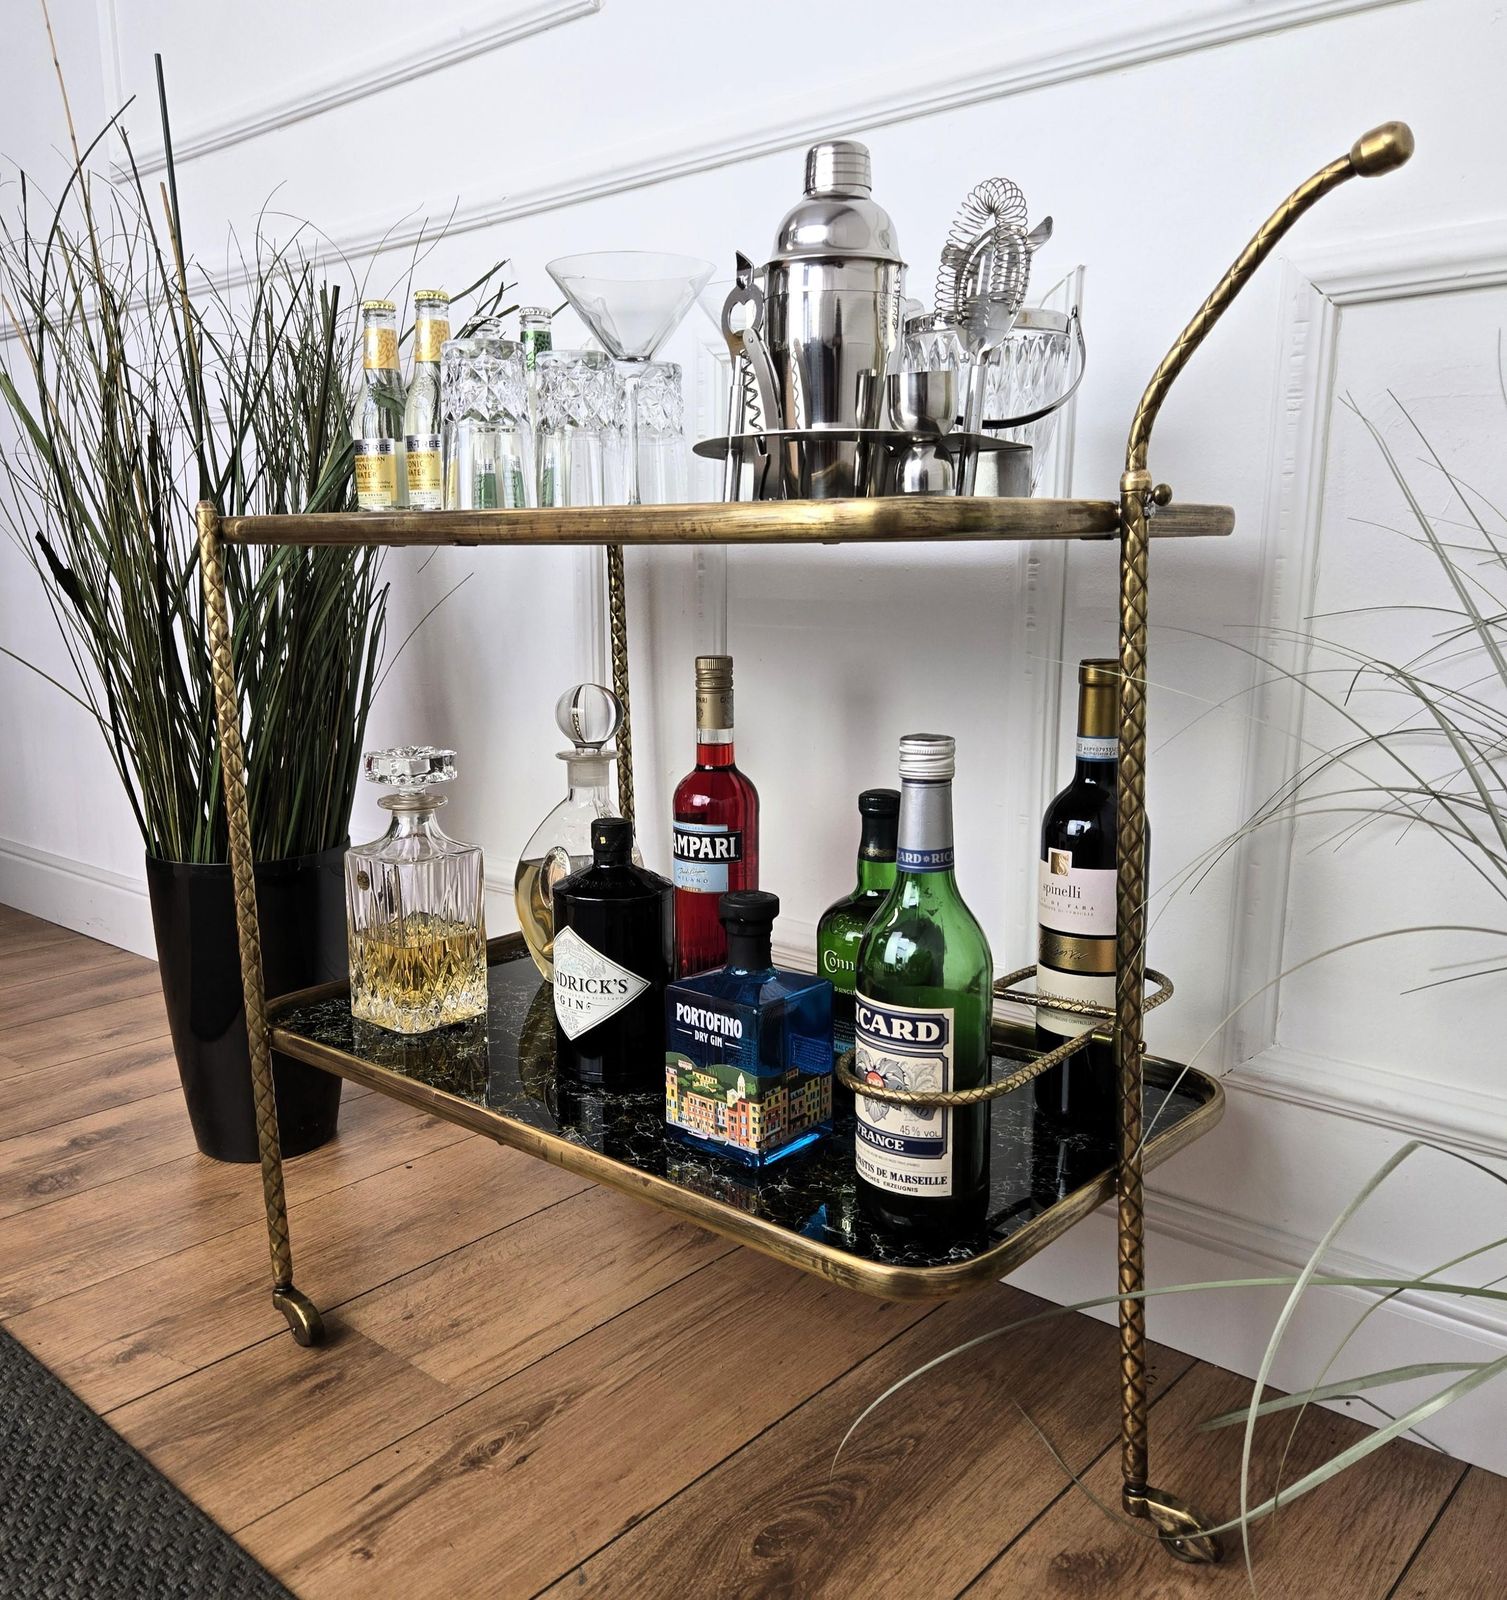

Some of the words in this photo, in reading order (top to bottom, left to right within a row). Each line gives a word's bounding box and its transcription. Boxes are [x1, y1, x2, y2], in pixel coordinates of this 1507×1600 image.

[1043, 882, 1081, 899] spinelli
[559, 995, 584, 1010] GIN
[676, 1002, 743, 1039] PORTOFINO
[694, 1030, 709, 1043] DRY
[710, 1034, 723, 1048] GIN
[856, 1121, 905, 1151] FRANCE
[876, 1166, 888, 1179] DE
[889, 1171, 948, 1186] MARSEILLE
